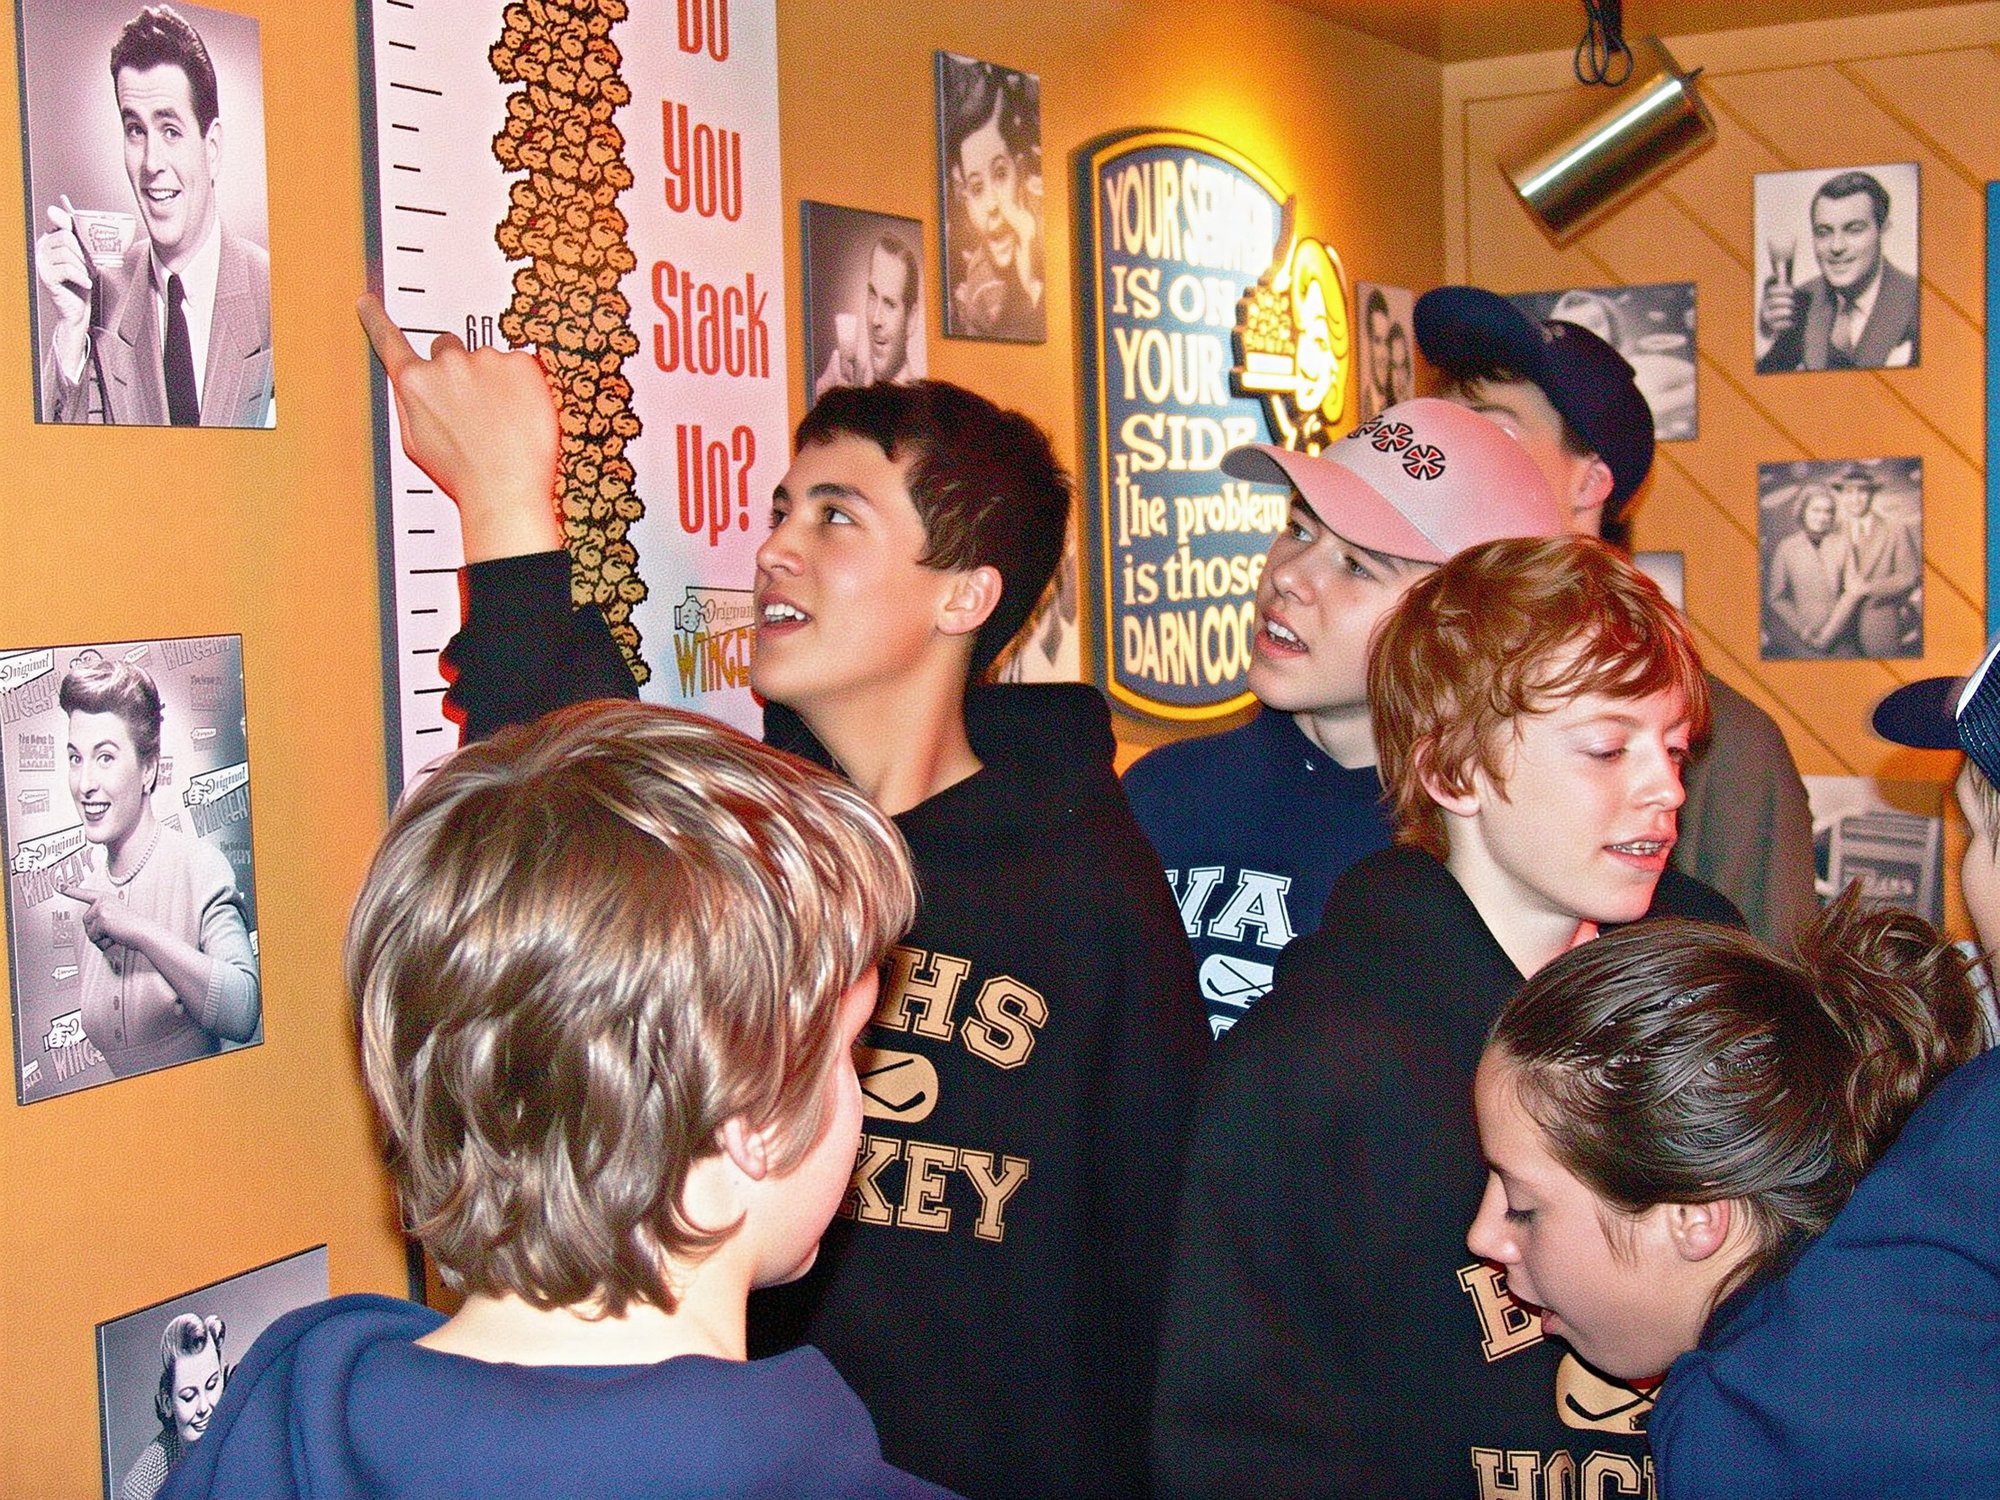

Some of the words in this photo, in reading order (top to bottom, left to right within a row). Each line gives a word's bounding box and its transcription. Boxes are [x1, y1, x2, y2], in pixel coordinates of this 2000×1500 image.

[661, 99, 741, 221] You
[1105, 159, 1181, 261] YOUR
[651, 259, 769, 378] Stack
[1111, 264, 1161, 320] IS
[1167, 274, 1236, 328] ON
[1113, 326, 1229, 407] YOUR
[677, 422, 756, 547] Up?
[1173, 482, 1288, 545] problem
[1123, 553, 1159, 606] is
[1122, 608, 1199, 688] DARN
